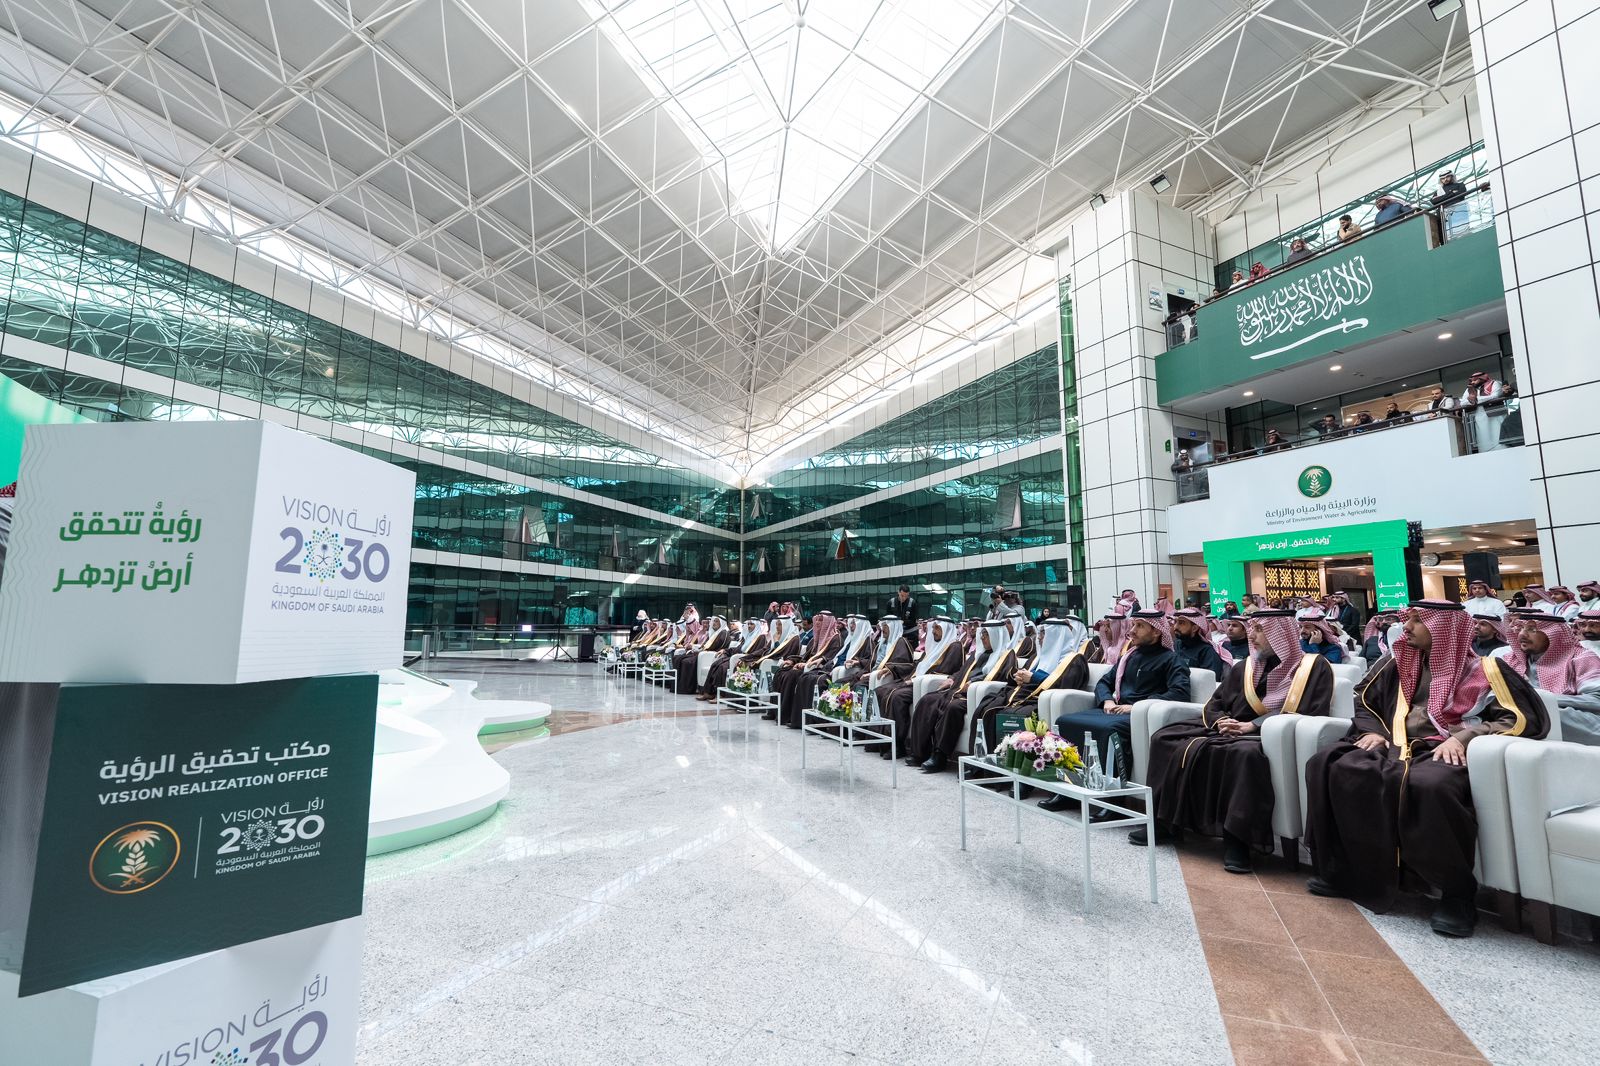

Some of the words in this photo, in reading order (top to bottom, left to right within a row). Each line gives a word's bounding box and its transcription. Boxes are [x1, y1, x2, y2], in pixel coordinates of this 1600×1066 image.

[1296, 503, 1327, 515] والمياه
[1328, 499, 1352, 511] البيئة
[1354, 496, 1377, 508] وزارة
[282, 495, 344, 527] VISION
[1265, 507, 1295, 519] والزراعة
[1324, 512, 1340, 520] Water
[1347, 507, 1377, 517] Agriculture
[59, 511, 145, 542] تتحقق
[346, 508, 391, 537] رؤية
[272, 582, 321, 598] السعودية
[323, 587, 351, 600] العربية
[353, 590, 386, 602] المملكة
[271, 600, 316, 611] KINGDOM
[318, 602, 330, 612] OF
[332, 603, 355, 613] SAUDI
[357, 604, 384, 614] ARABIA
[181, 746, 260, 775] تحقيق
[265, 741, 331, 766] مكتب
[99, 753, 176, 784] الرؤية
[98, 786, 163, 805] VISION
[167, 773, 274, 797] REALIZATION
[277, 767, 329, 783] OFFICE
[279, 796, 325, 815] رؤية
[221, 805, 276, 824] VISION
[260, 847, 287, 860] العربية
[288, 842, 321, 854] المملكة
[215, 852, 259, 867] السعودية
[215, 863, 254, 875] KINGDOM
[255, 859, 267, 868] OF
[268, 856, 291, 865] SAUDI
[292, 850, 320, 860] ARABIA
[253, 973, 328, 1028] رؤية
